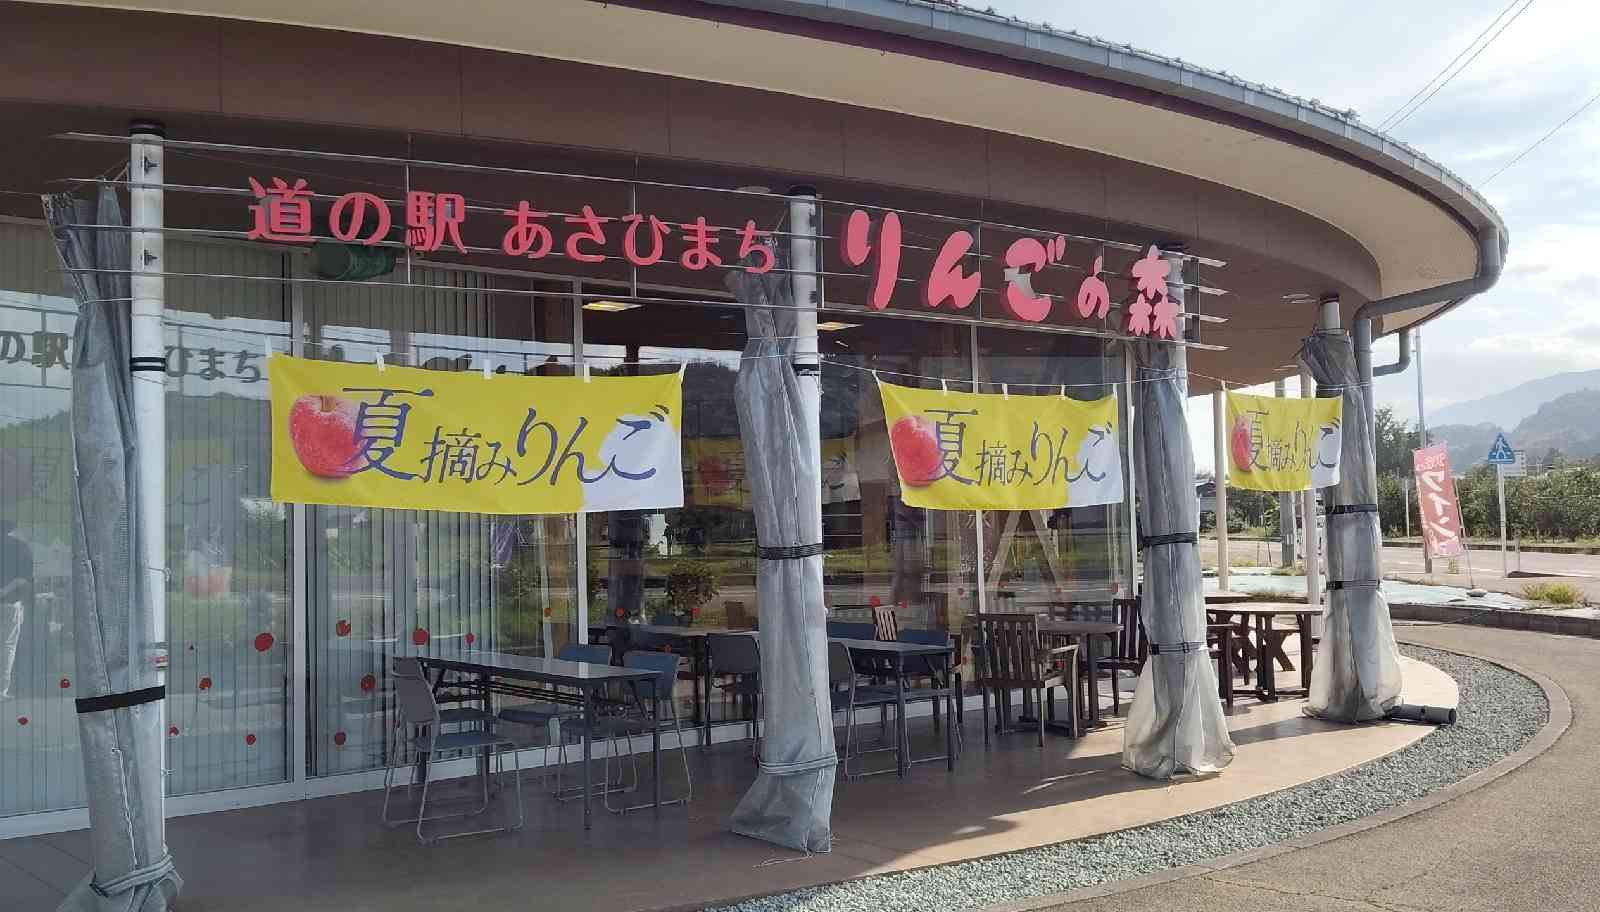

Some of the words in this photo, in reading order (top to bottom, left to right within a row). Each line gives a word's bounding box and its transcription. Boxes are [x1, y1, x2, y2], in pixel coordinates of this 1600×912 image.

[247, 176, 468, 254] 道の駅
[502, 200, 777, 274] あさひまち
[841, 209, 1180, 339] りんごの森
[339, 387, 671, 486] 夏摘みりんご
[924, 408, 1113, 487] 夏摘みりんご
[1246, 409, 1341, 473] 夏摘みりんご
